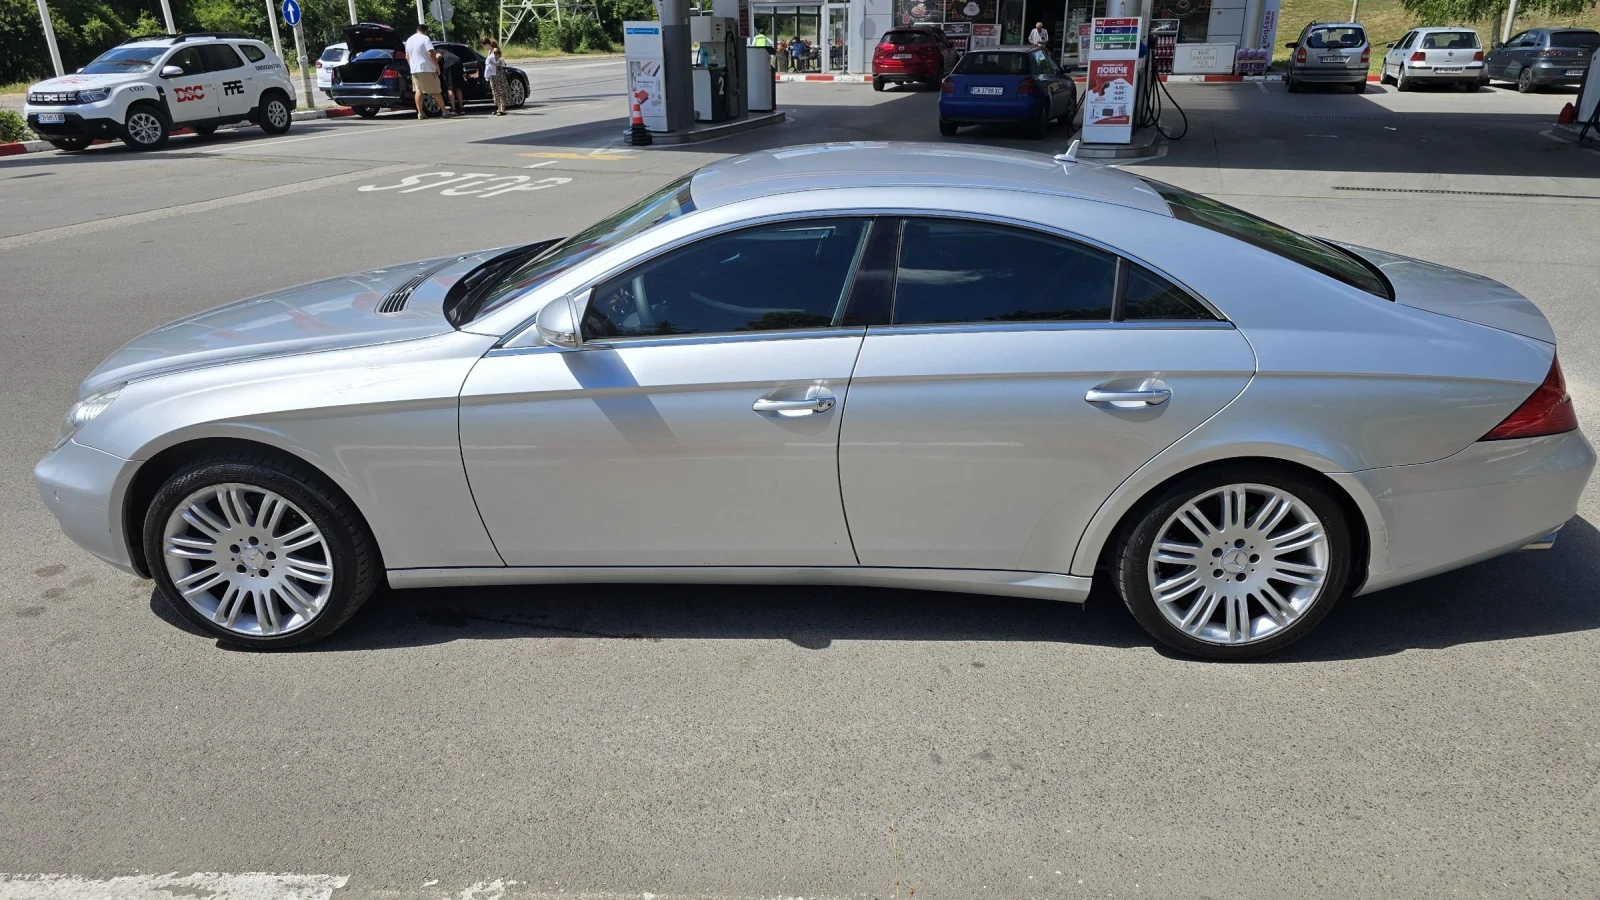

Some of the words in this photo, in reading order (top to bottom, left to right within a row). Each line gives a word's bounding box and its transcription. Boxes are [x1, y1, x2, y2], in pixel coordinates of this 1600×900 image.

[1262, 10, 1272, 46] easybox
[173, 85, 205, 103] DSC
[718, 76, 724, 95] 2
[357, 171, 573, 198] STOP
